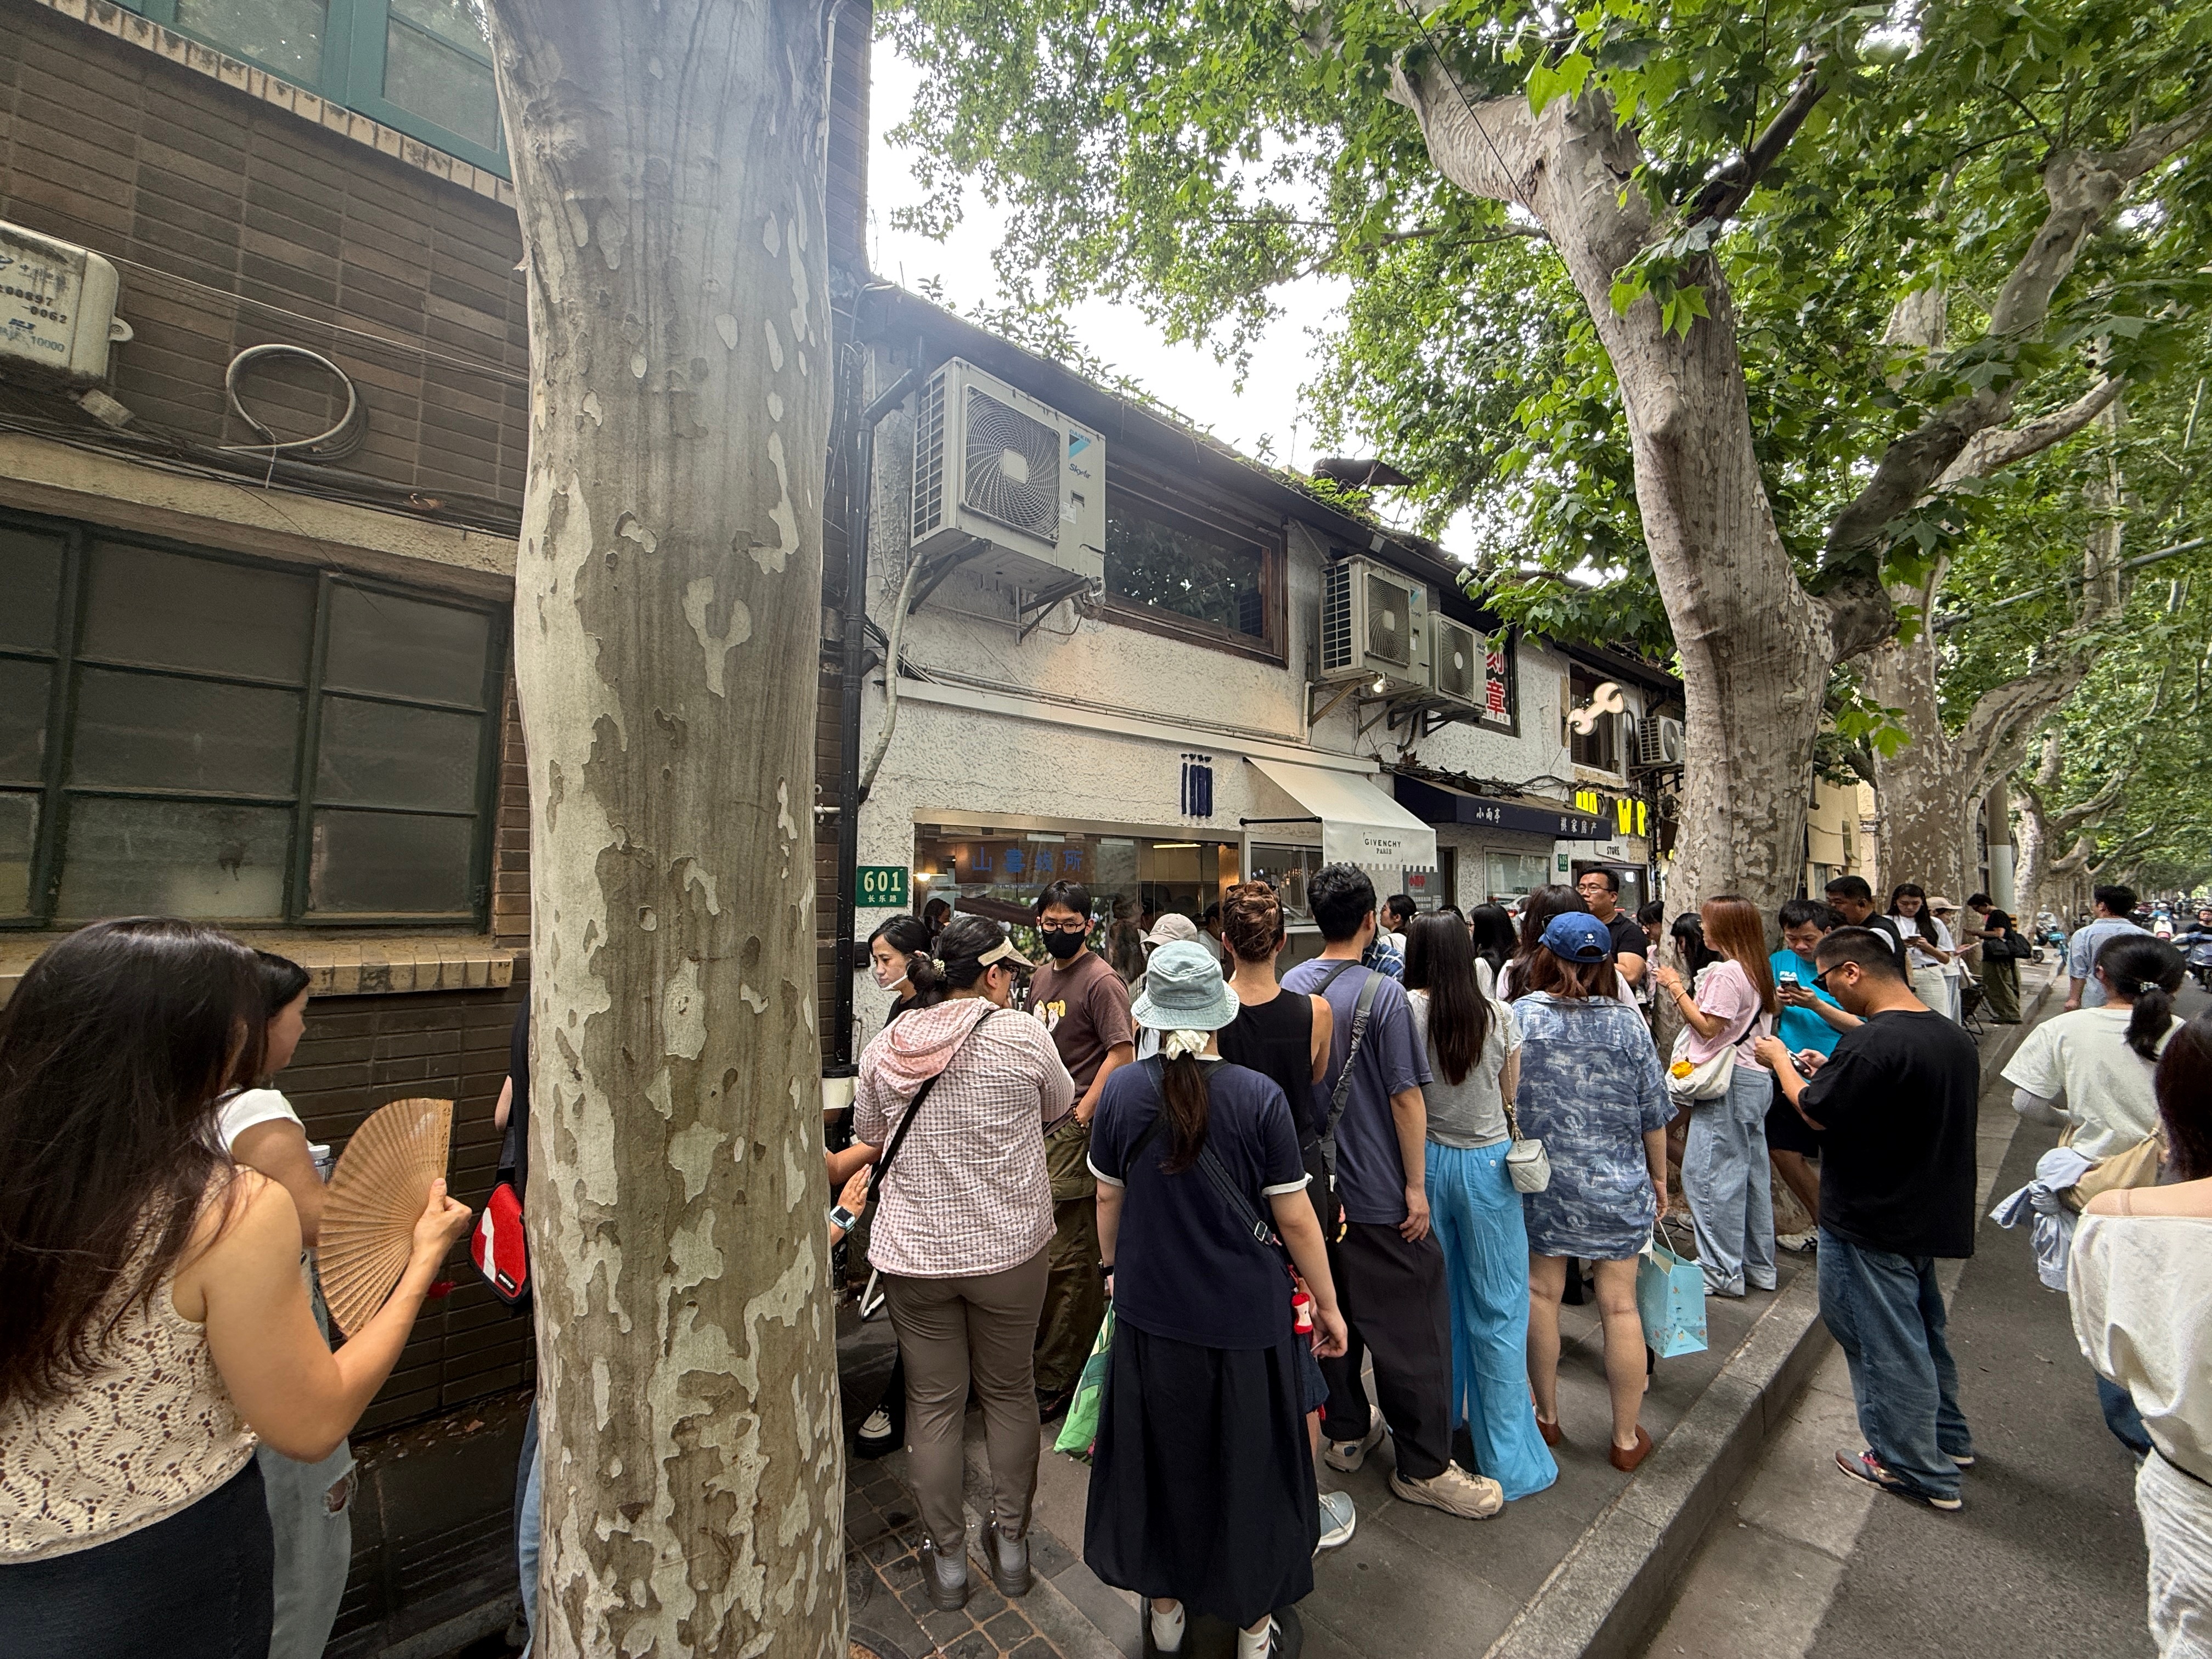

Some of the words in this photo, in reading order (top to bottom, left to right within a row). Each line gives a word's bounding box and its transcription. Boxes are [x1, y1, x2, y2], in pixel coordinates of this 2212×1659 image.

[1069, 429, 1091, 444] DAIKIN
[1364, 838, 1401, 848] GIVENCHY
[1607, 845, 1620, 856] STORE
[864, 871, 901, 892] 601
